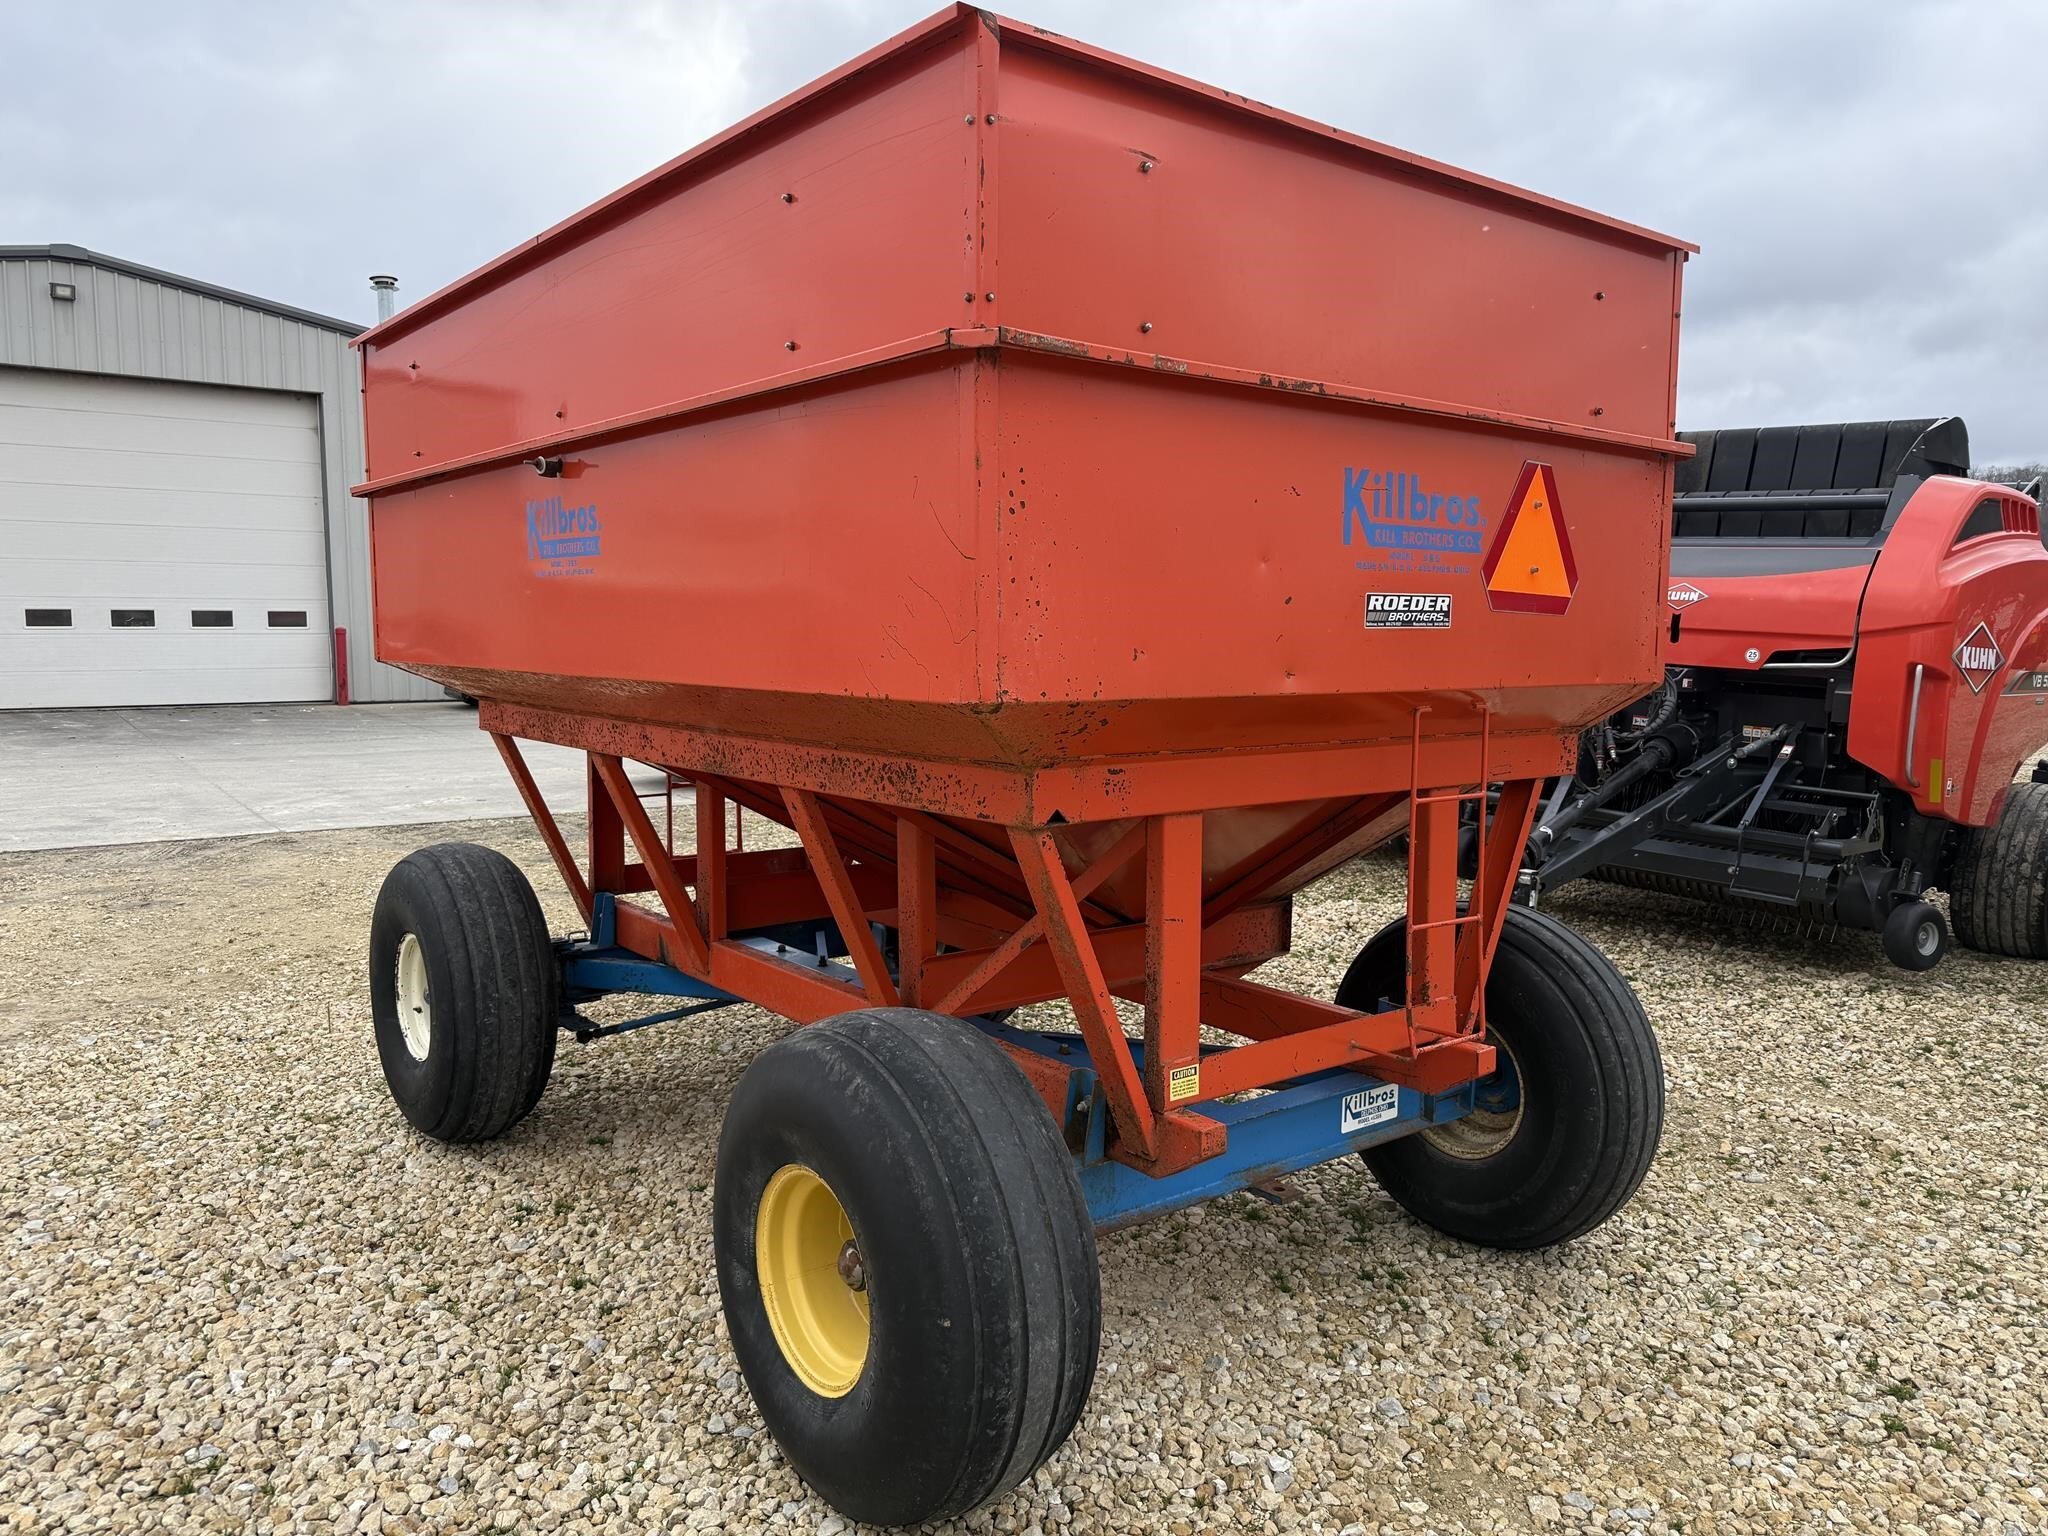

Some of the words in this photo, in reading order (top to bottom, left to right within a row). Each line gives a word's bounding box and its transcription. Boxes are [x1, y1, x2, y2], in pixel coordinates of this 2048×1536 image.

[1375, 529, 1396, 544] KILL
[1402, 531, 1455, 547] BROTHERS
[1367, 595, 1450, 611] ROEDER
[1388, 612, 1445, 622] BROTHERS
[1962, 646, 1997, 670] KUHN
[2032, 674, 2042, 688] VB
[1173, 1067, 1196, 1080] CAUTION
[1343, 1088, 1395, 1123] Killbros
